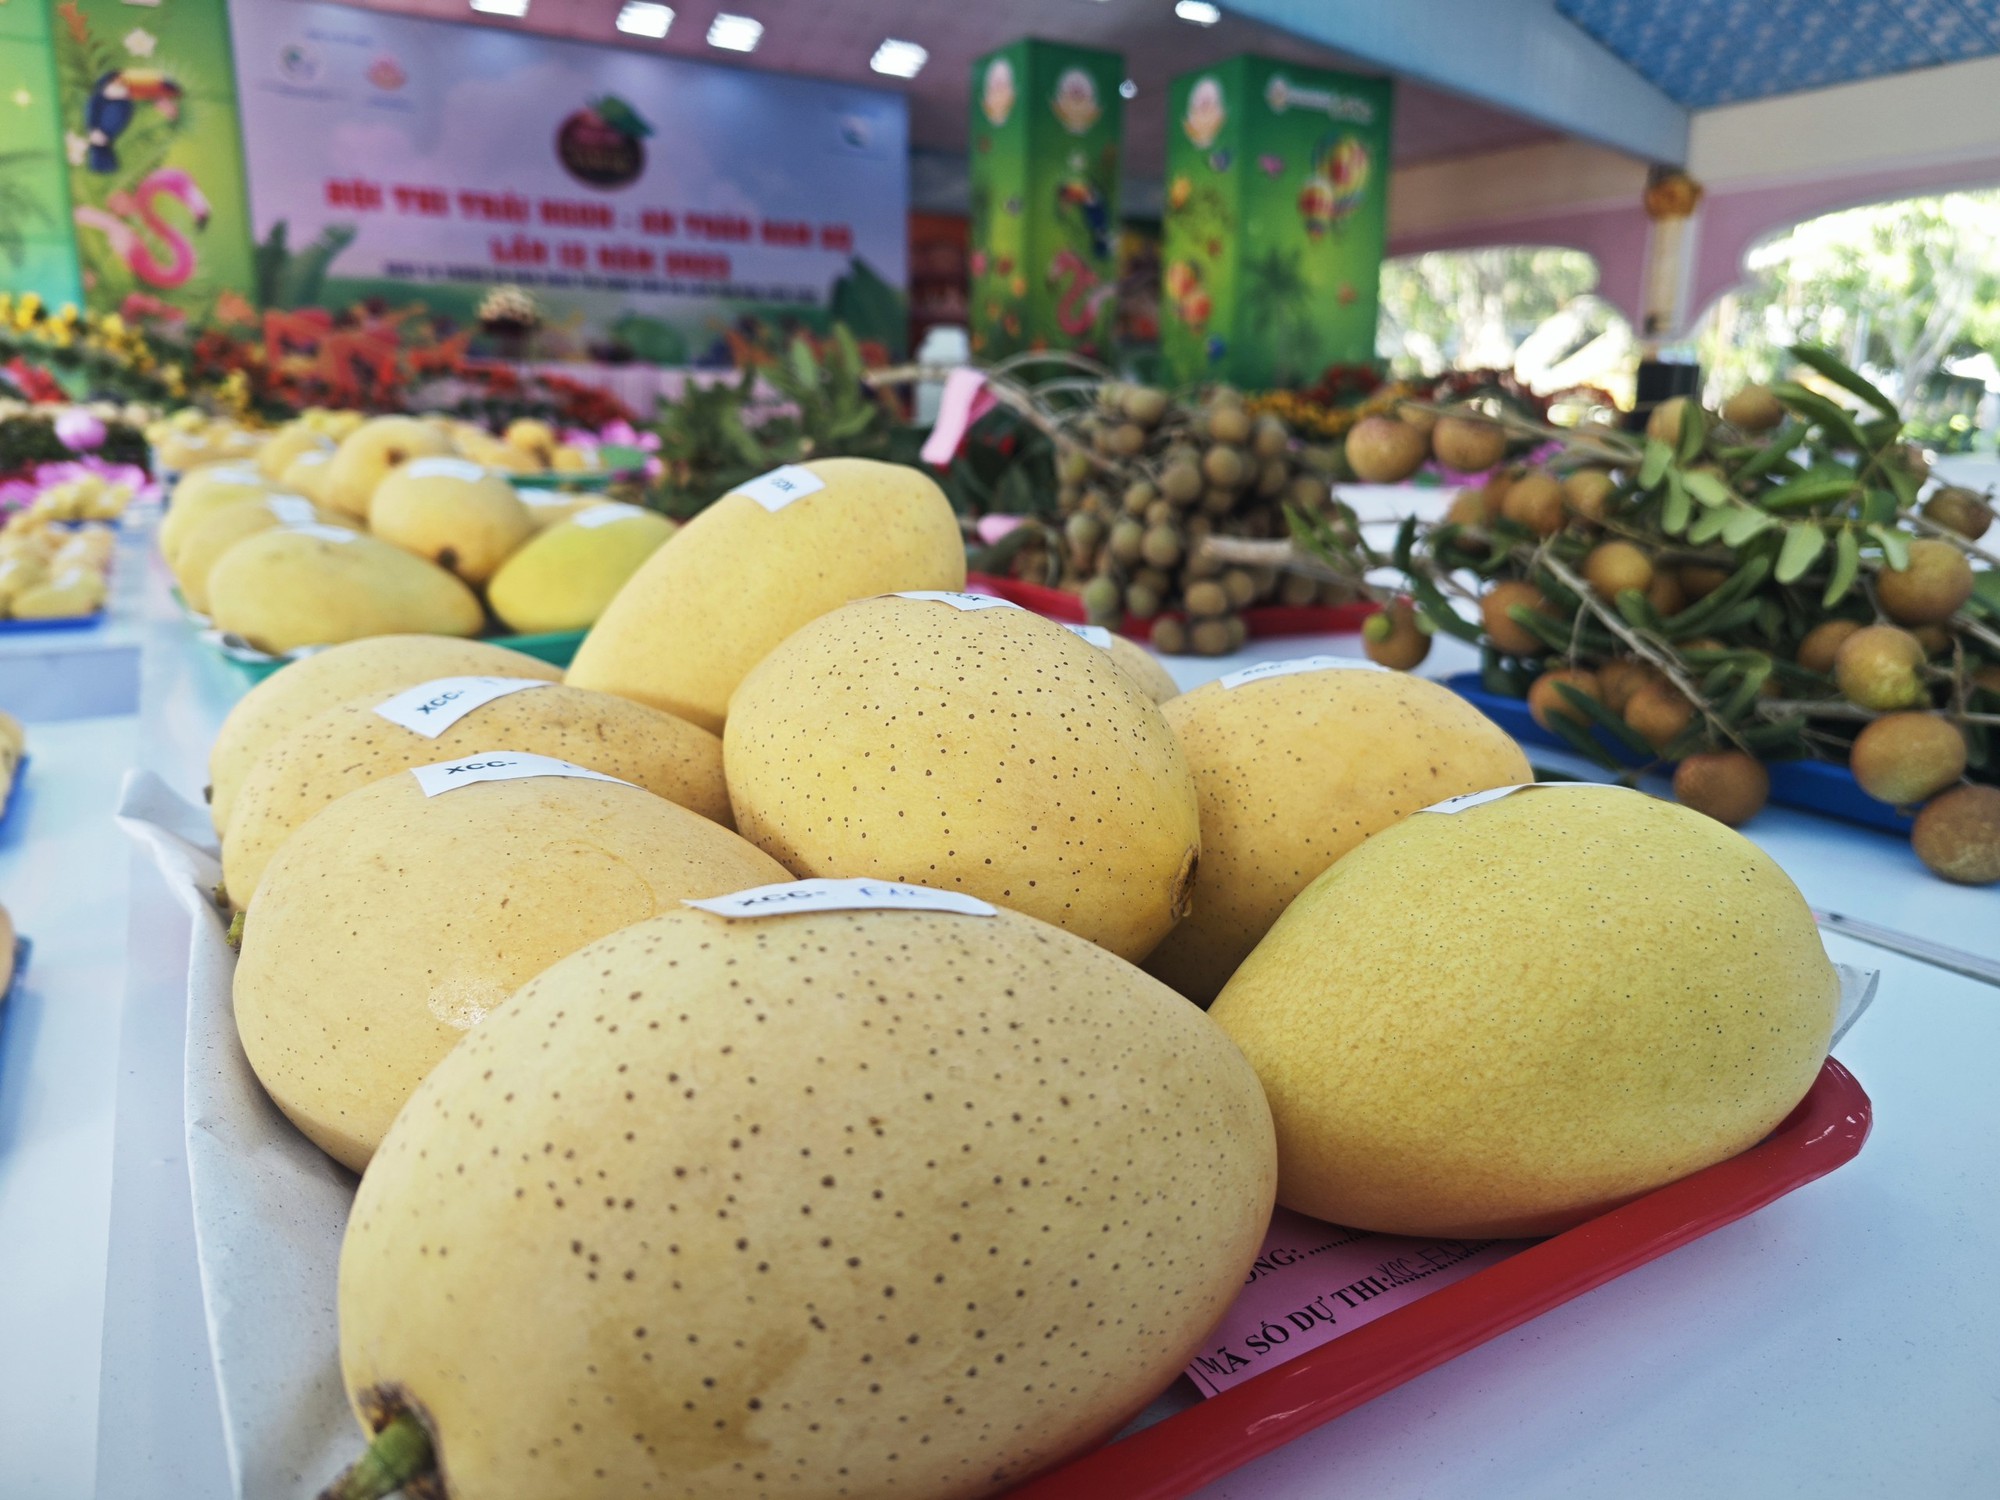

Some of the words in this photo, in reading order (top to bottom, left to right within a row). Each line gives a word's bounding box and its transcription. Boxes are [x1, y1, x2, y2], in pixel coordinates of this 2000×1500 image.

[416, 689, 465, 715] XCC-
[445, 760, 517, 775] XCC-
[1195, 1347, 1251, 1375] MÃ
[1245, 1321, 1289, 1356] SỐ
[1285, 1296, 1336, 1332] DỰ
[1330, 1276, 1397, 1308] THI:
